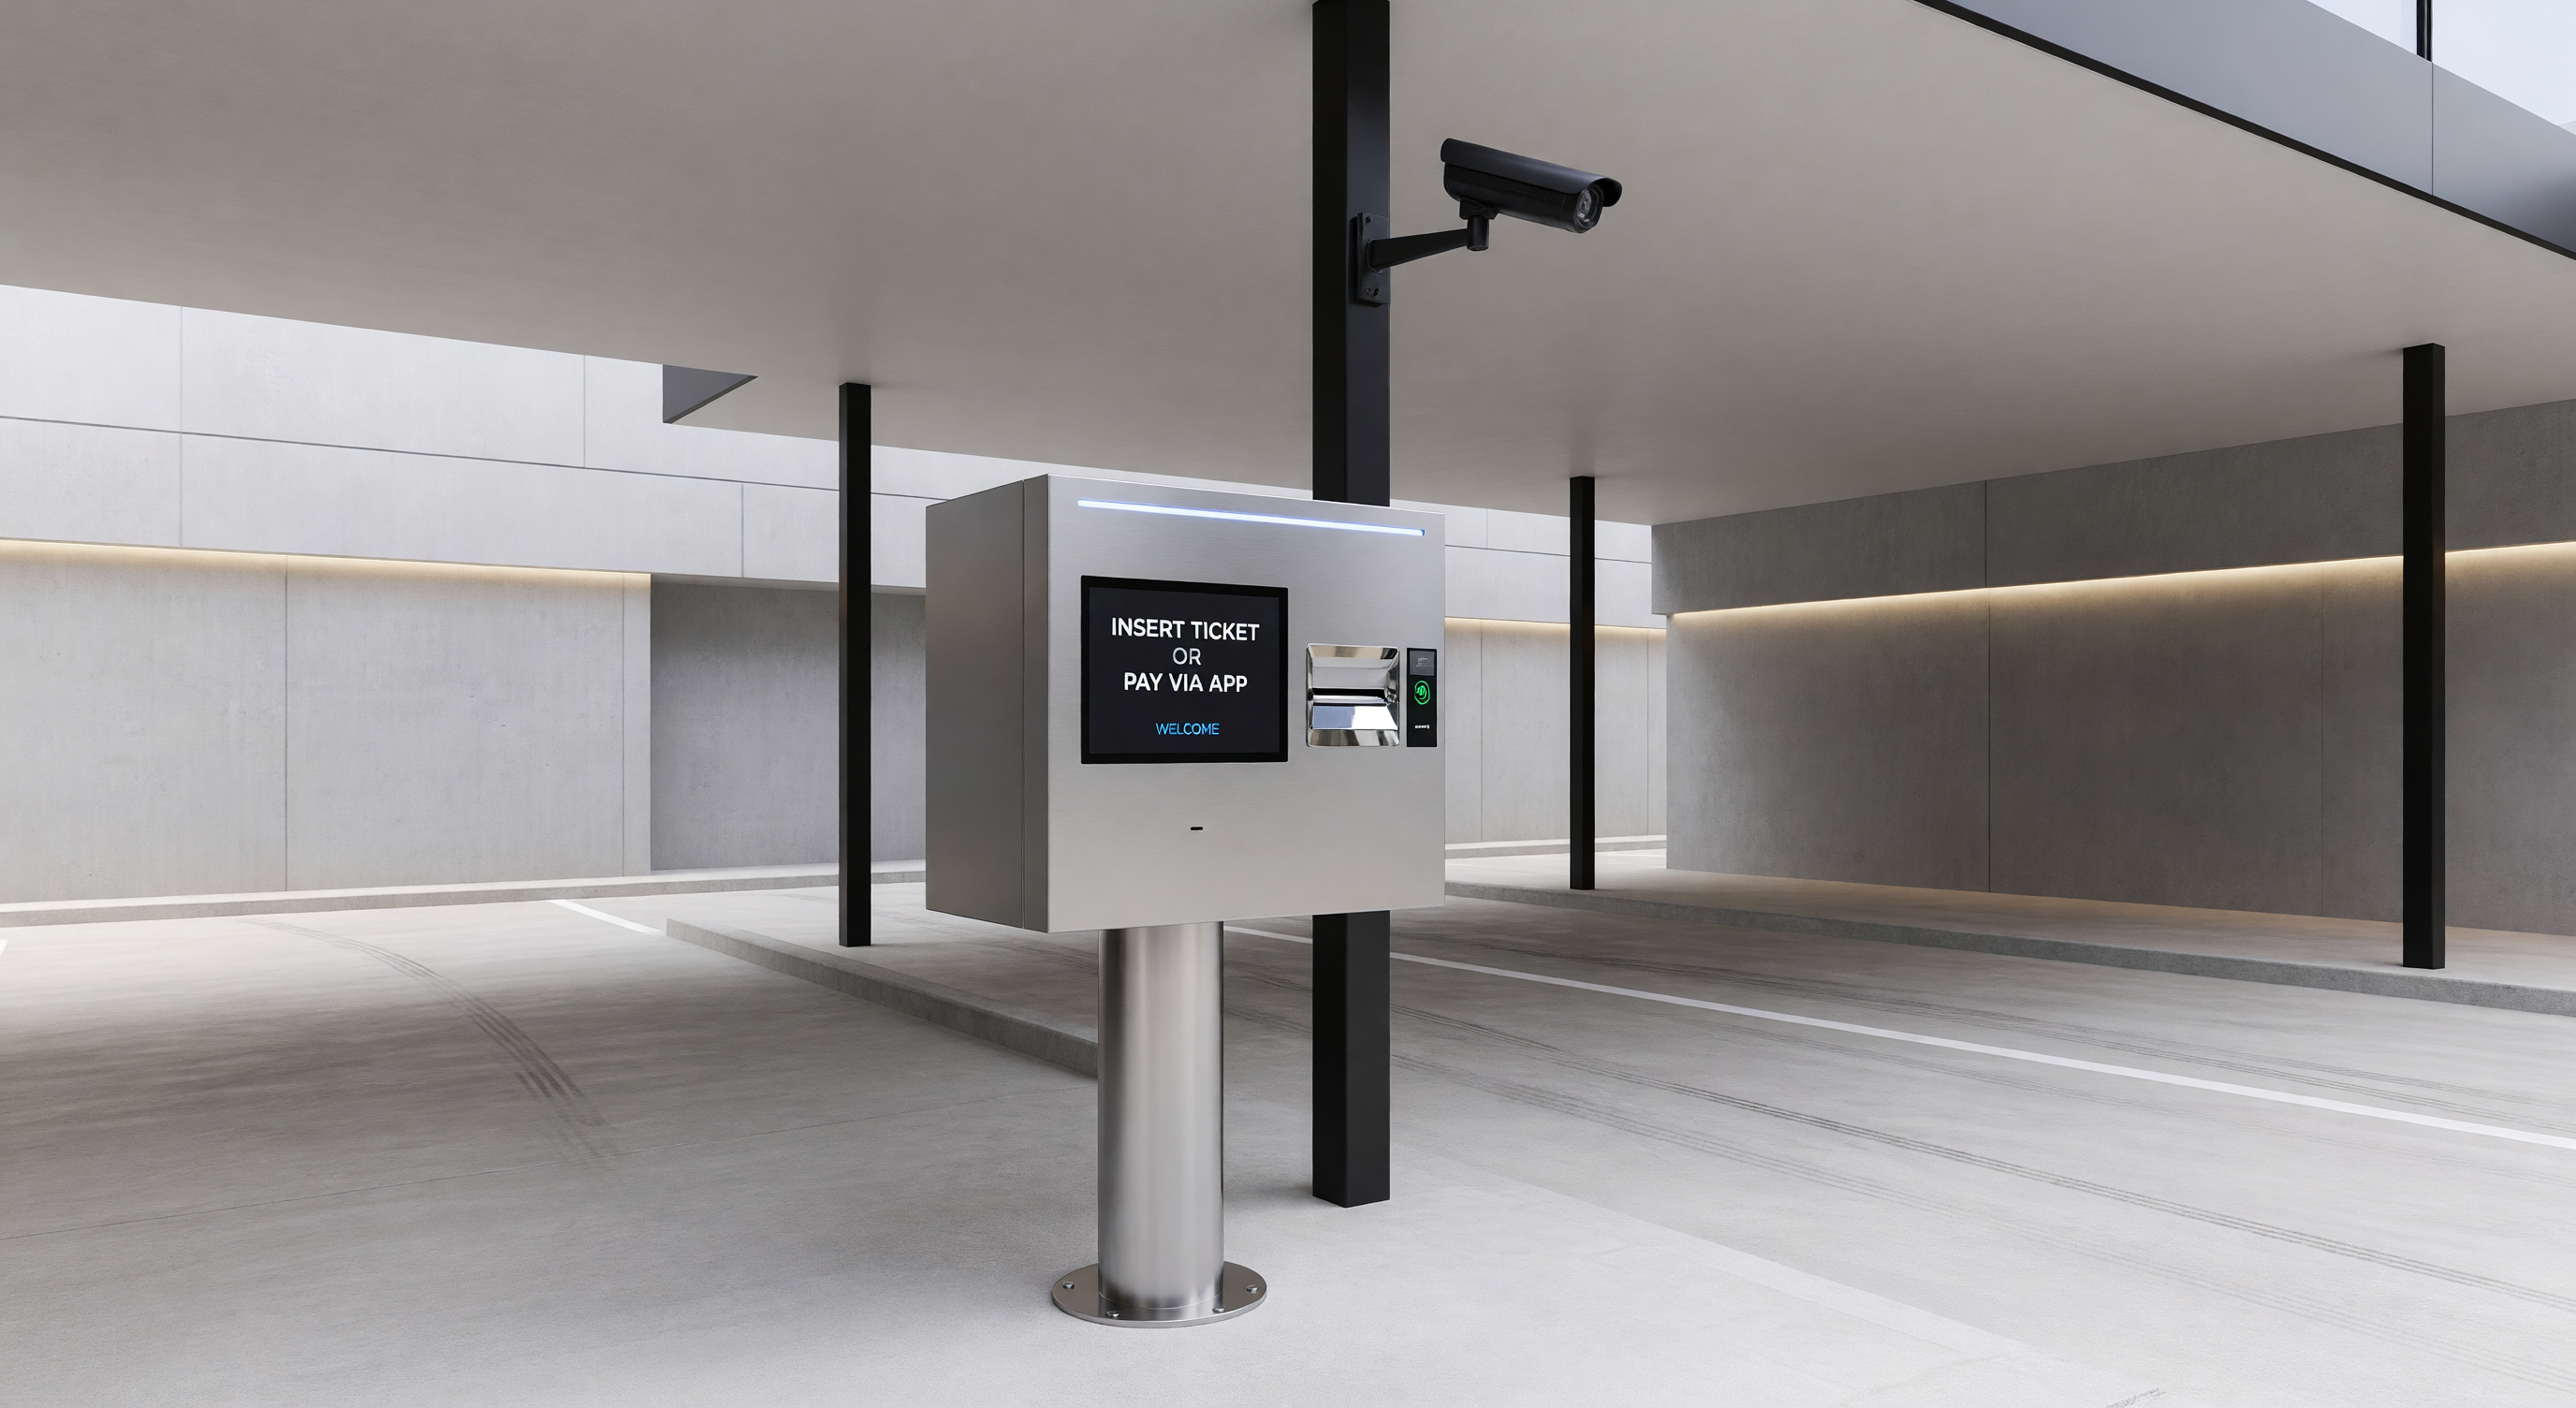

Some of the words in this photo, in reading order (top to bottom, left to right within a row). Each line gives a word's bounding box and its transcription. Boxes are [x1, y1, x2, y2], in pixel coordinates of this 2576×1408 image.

[1111, 617, 1186, 638] INSERT
[1190, 621, 1261, 641] TICKET
[1172, 647, 1202, 666] OR
[1123, 671, 1164, 692] PAY
[1168, 672, 1205, 693] VIA
[1208, 674, 1248, 693] APP
[1155, 722, 1220, 736] WELCOME
